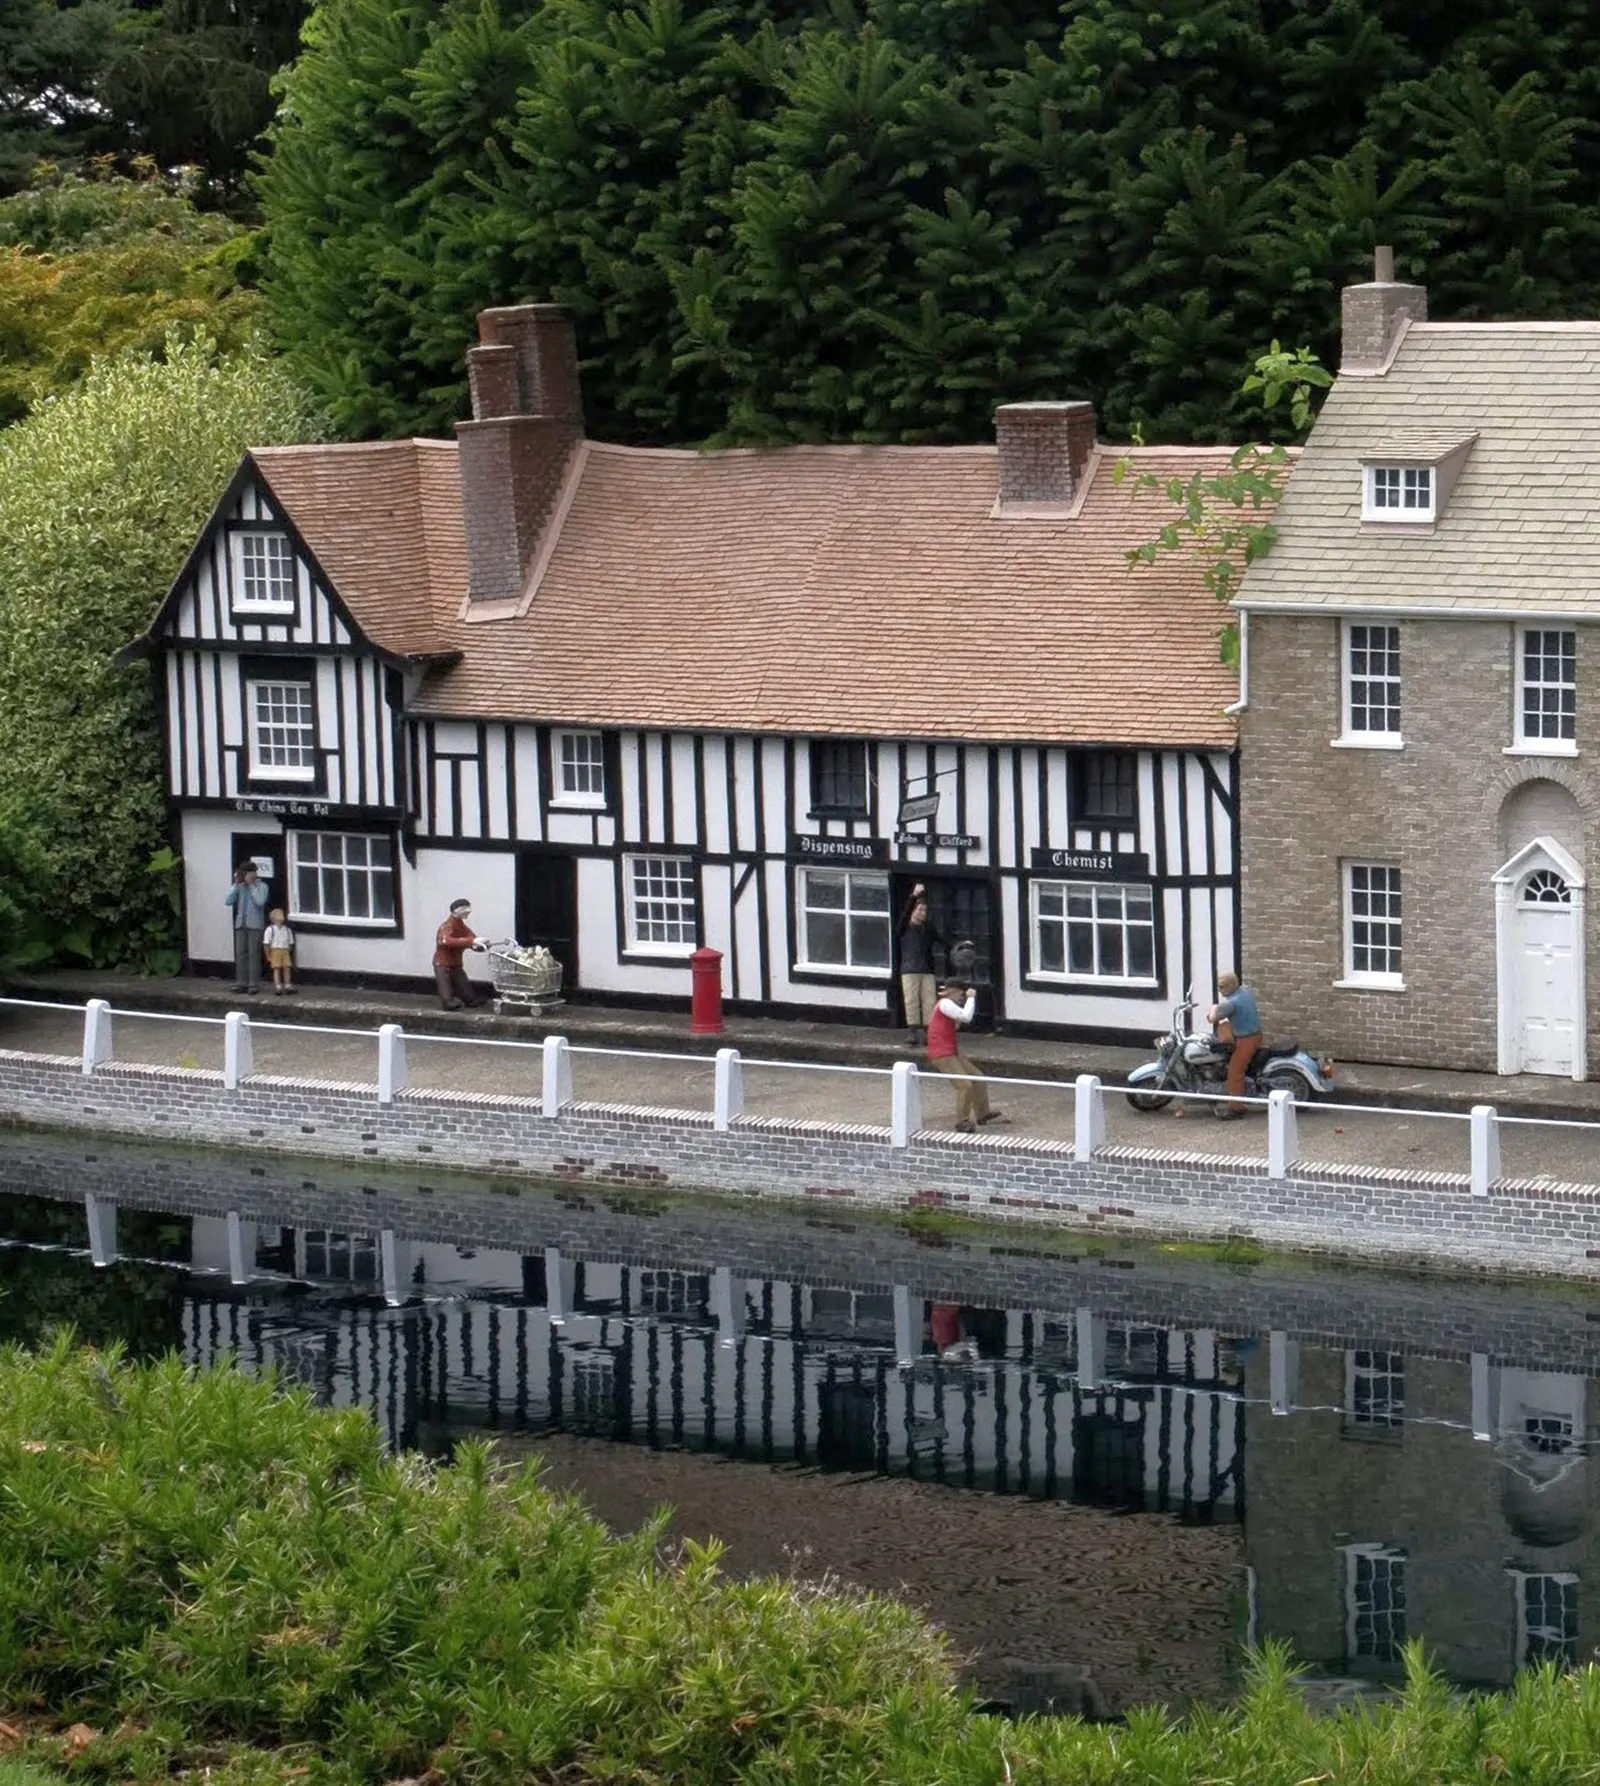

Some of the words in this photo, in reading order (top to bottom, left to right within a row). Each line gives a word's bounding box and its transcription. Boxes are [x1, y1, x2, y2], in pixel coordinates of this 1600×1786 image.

[235, 799, 253, 811] The
[258, 801, 286, 813] China
[290, 802, 307, 814] Tea
[313, 803, 328, 815] Pot
[801, 836, 873, 859] Dispensing
[1052, 851, 1113, 869] Chemist
